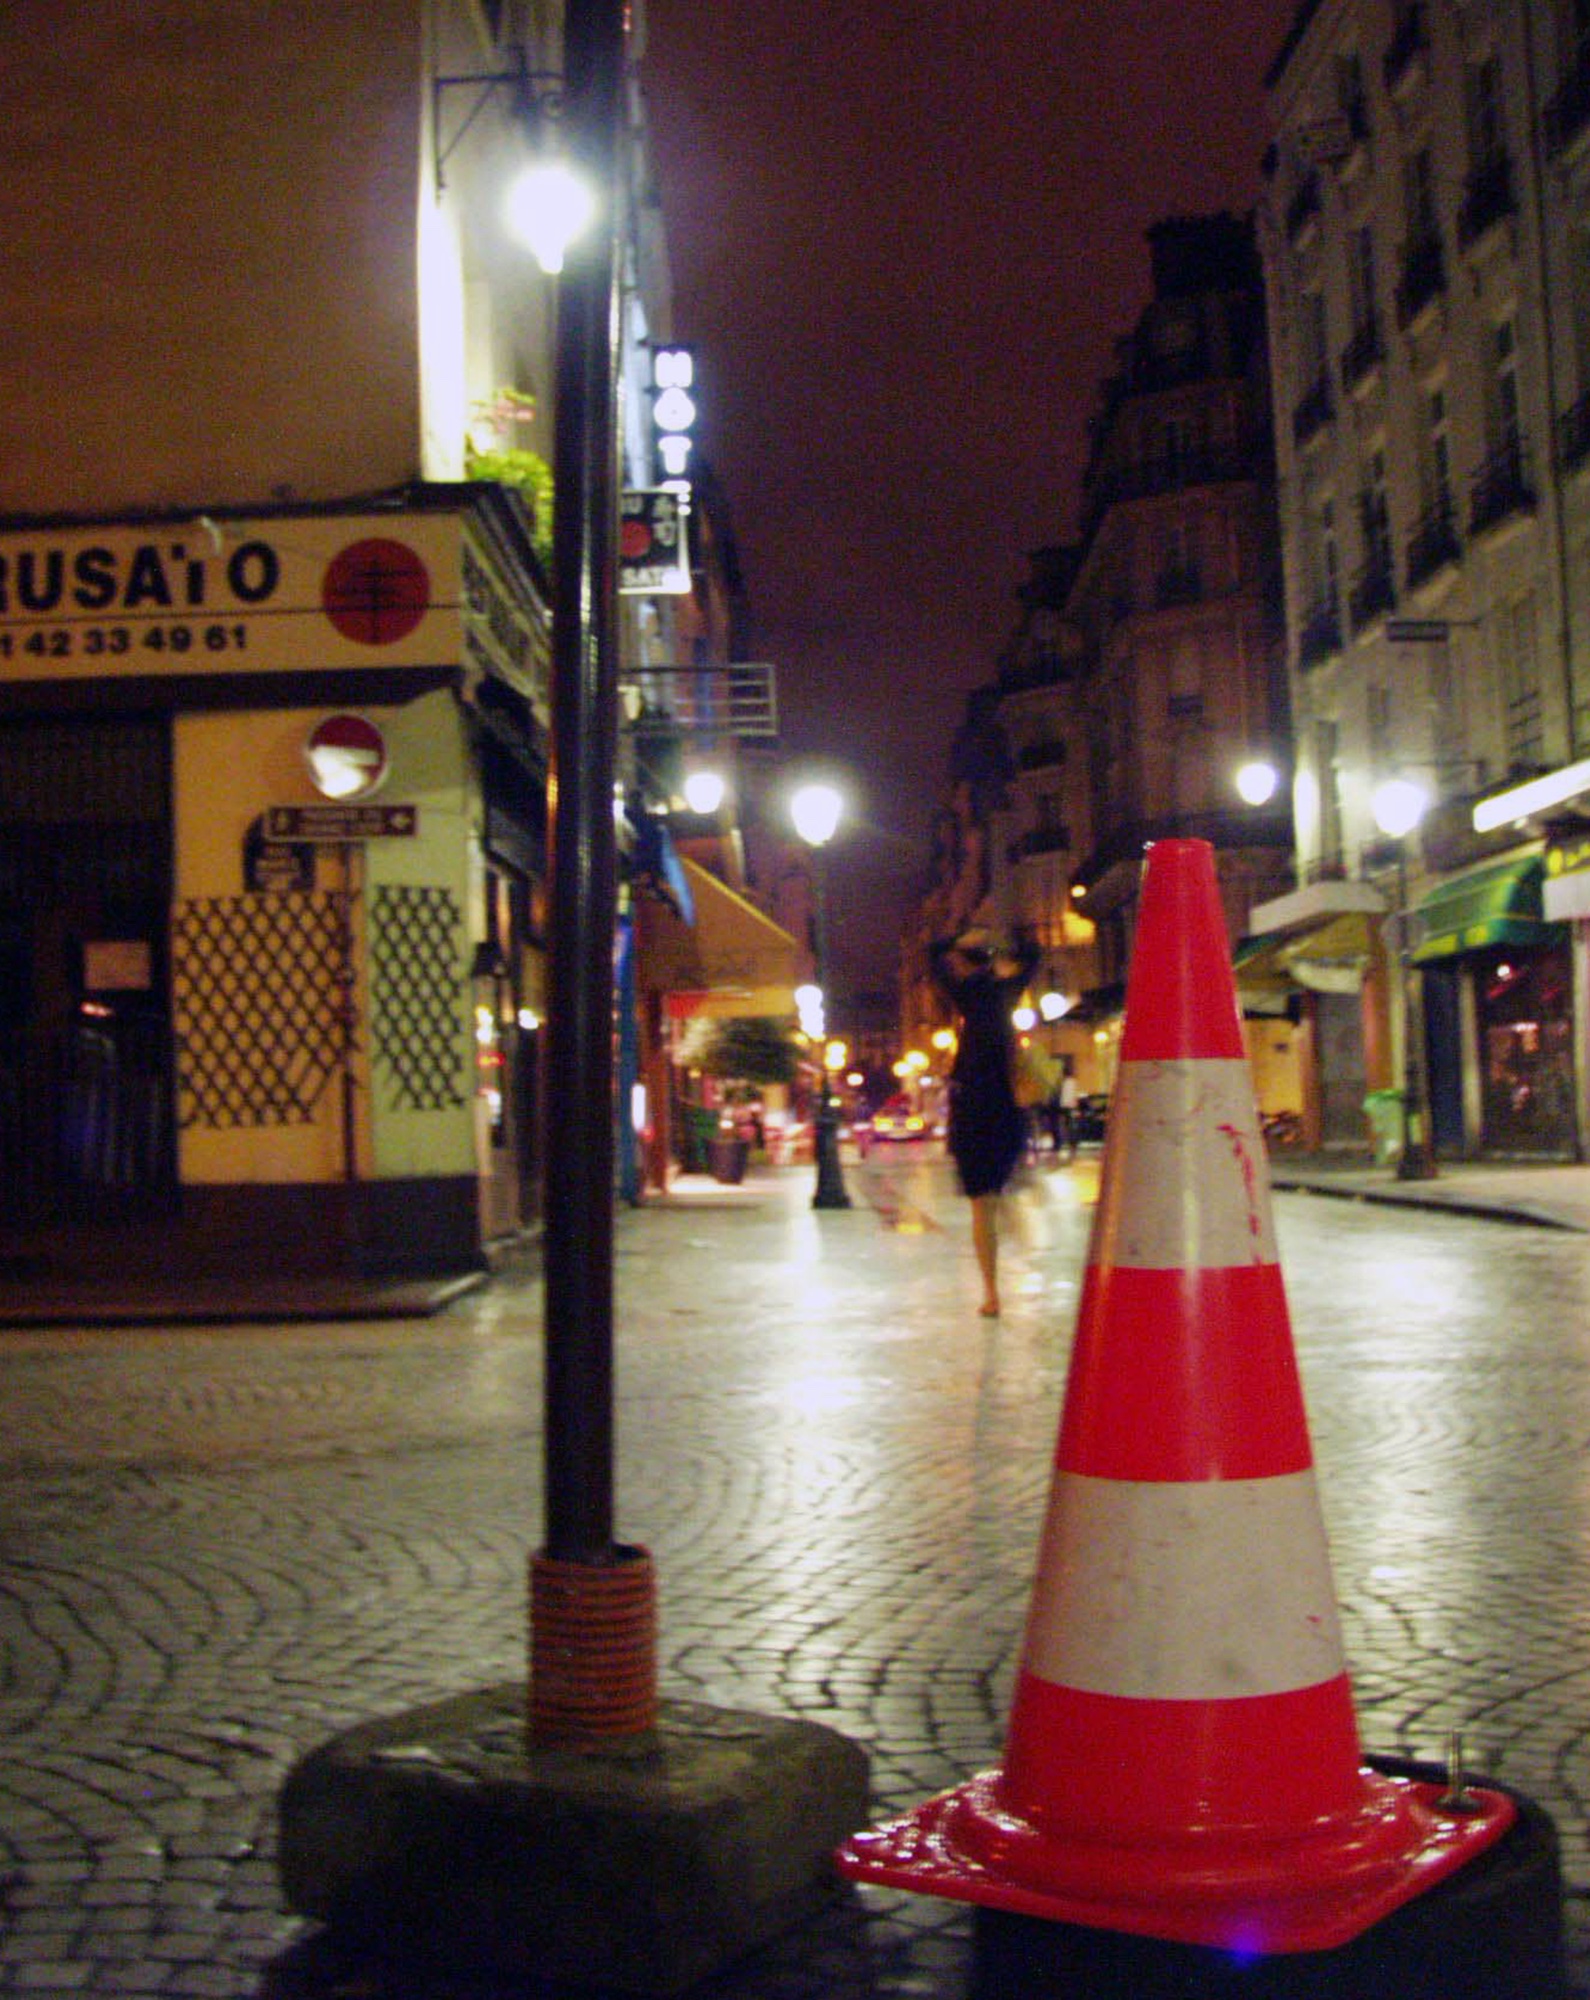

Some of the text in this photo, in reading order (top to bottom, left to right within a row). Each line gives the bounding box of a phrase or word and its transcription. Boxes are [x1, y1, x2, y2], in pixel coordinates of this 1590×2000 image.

[25, 629, 71, 657] 42
[84, 625, 131, 654] 33
[144, 625, 193, 653] 49
[204, 623, 247, 652] 61
